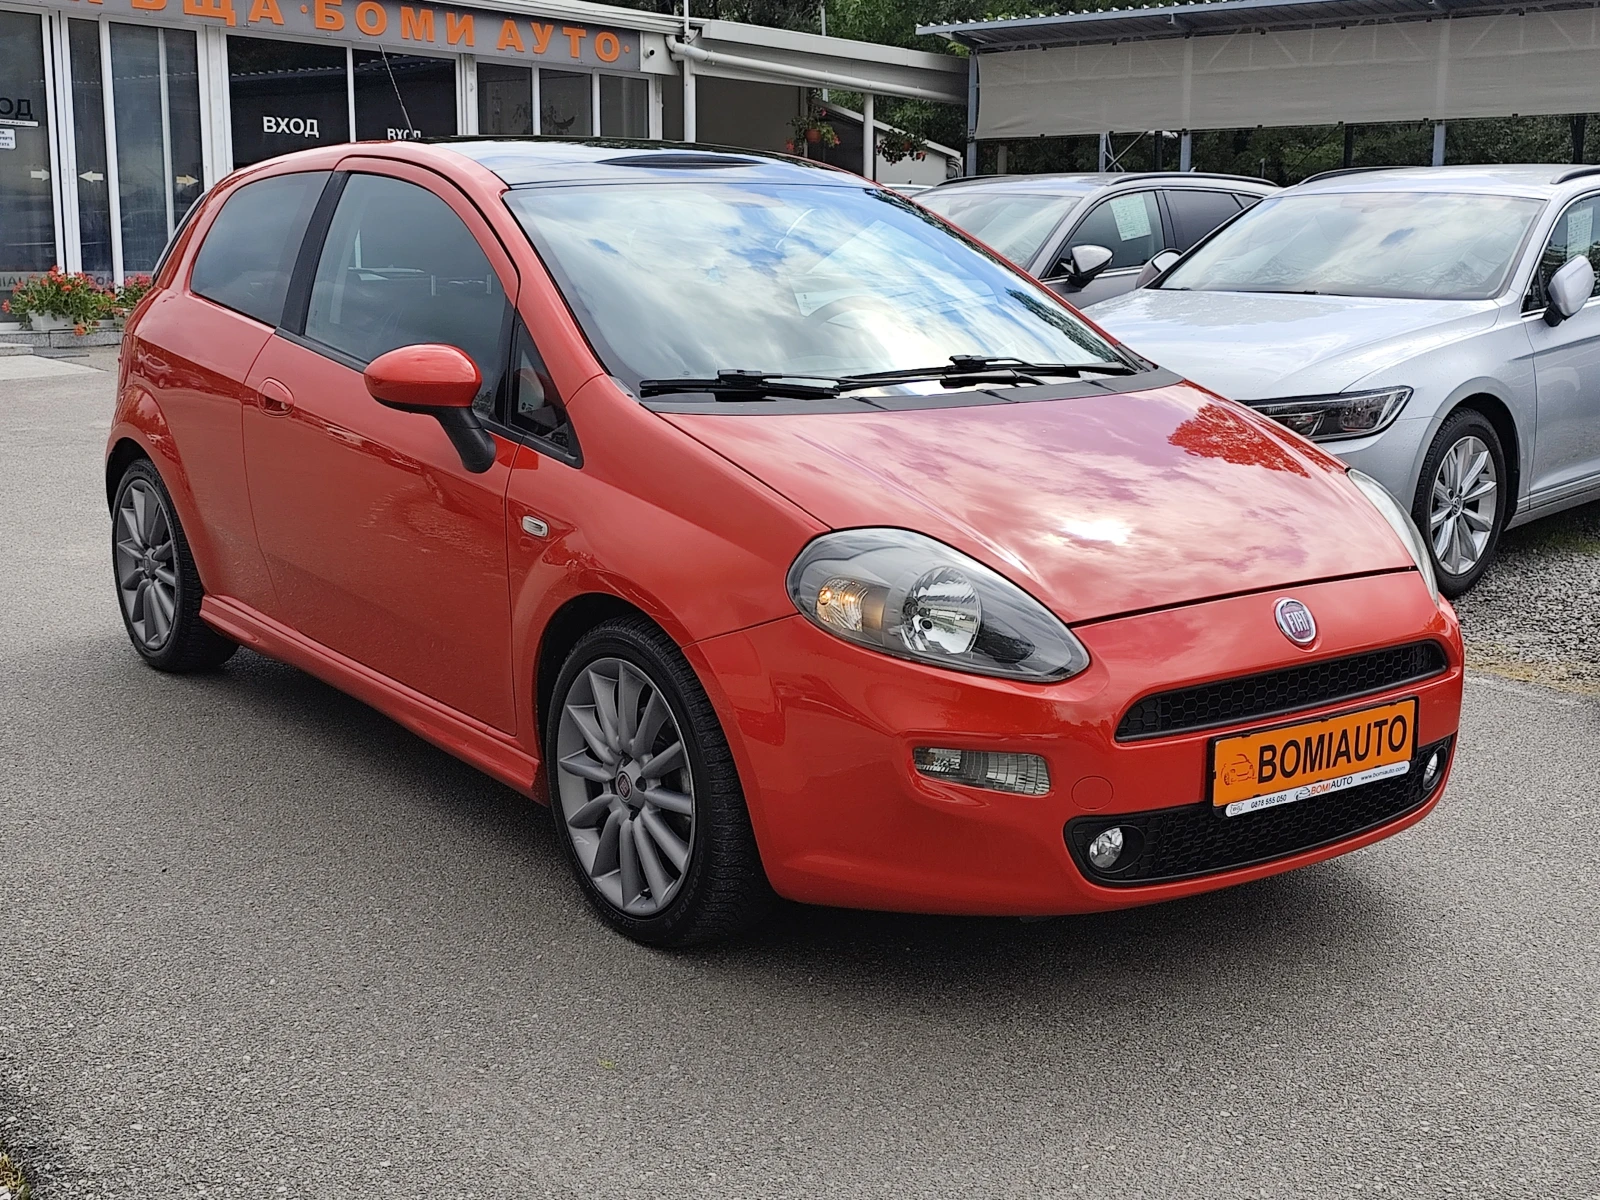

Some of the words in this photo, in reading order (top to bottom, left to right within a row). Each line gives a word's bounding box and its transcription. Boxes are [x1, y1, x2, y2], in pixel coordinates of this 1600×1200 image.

[314, 0, 475, 47] БОМИ
[496, 19, 621, 63] АУТО
[262, 116, 320, 139] ВХОД
[1285, 610, 1310, 633] FIAT
[1257, 714, 1408, 784] BOMIAUTO
[1310, 776, 1353, 795] BOMIAUTO
